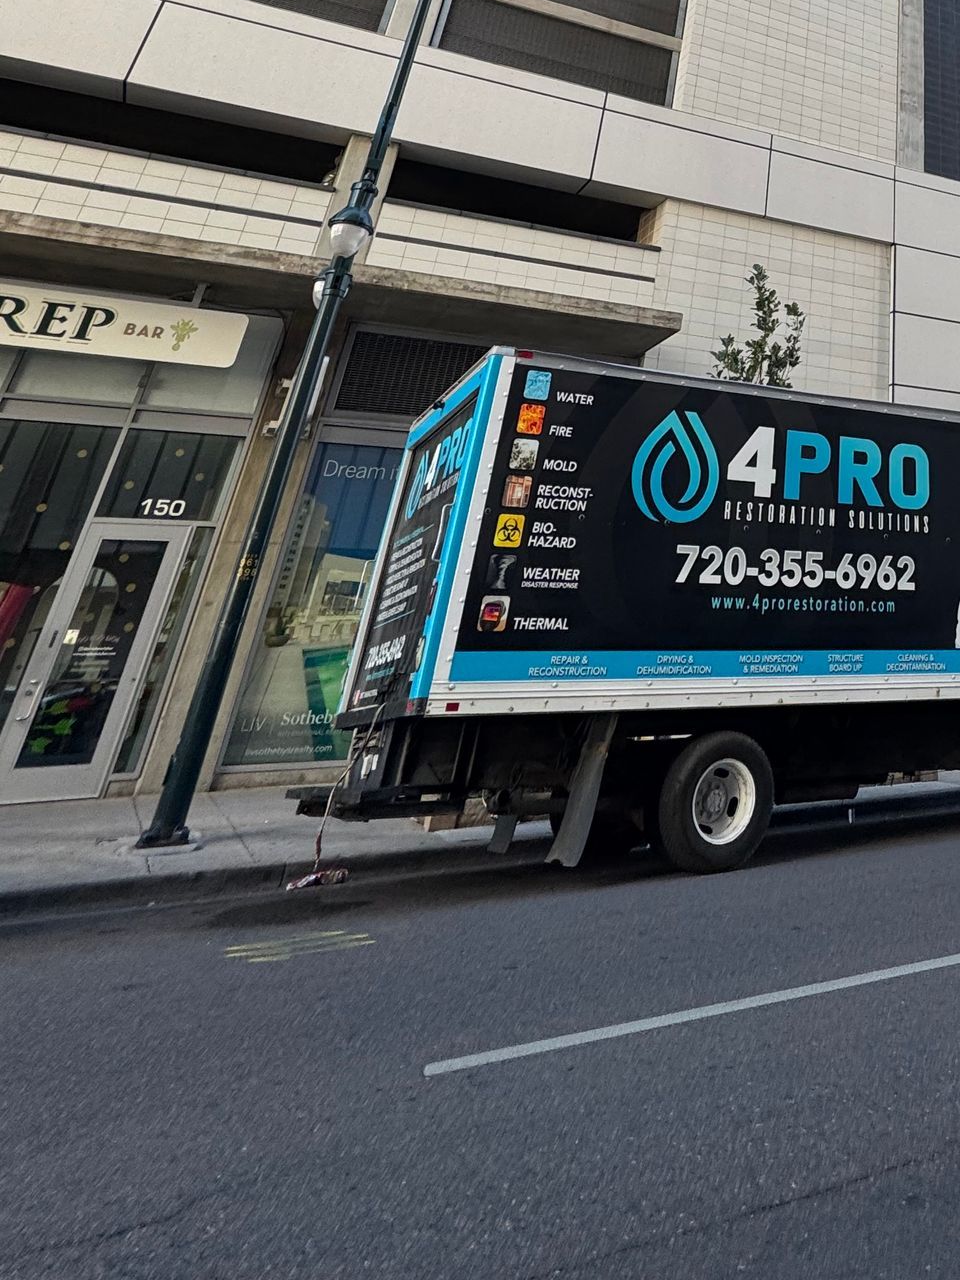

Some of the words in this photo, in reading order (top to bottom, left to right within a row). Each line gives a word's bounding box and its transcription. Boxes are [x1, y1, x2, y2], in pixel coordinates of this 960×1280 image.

[123, 322, 164, 339] BAR
[556, 391, 594, 405] WATER
[549, 425, 573, 437] FIRE
[323, 460, 386, 480] Dream
[543, 459, 577, 472] MOLD
[727, 426, 930, 510] 4PRO
[537, 485, 593, 499] RECONST-
[141, 499, 186, 517] 150
[535, 498, 587, 512] RUCTION
[724, 500, 836, 527] RESTORATION
[849, 510, 930, 534] SOLUTIONS
[532, 522, 557, 534] BIO-
[528, 535, 576, 548] HAZARD
[523, 567, 580, 580] WEATHER
[675, 544, 916, 591] 720-355-6962
[711, 593, 895, 614] www.4prorestoration.com
[513, 618, 569, 630] THERMAL
[551, 656, 580, 664] REPAIR
[582, 656, 588, 664] &
[657, 655, 686, 663] DRYING
[739, 655, 760, 663] MOLD
[762, 655, 803, 663] INSPECTION
[828, 654, 864, 662] STRUCTURE
[529, 667, 607, 676] RECONSTRUCTION
[637, 666, 712, 674] DEHUMIDIFICATION
[750, 664, 798, 672] REMEDIATION
[241, 717, 266, 732] LIV
